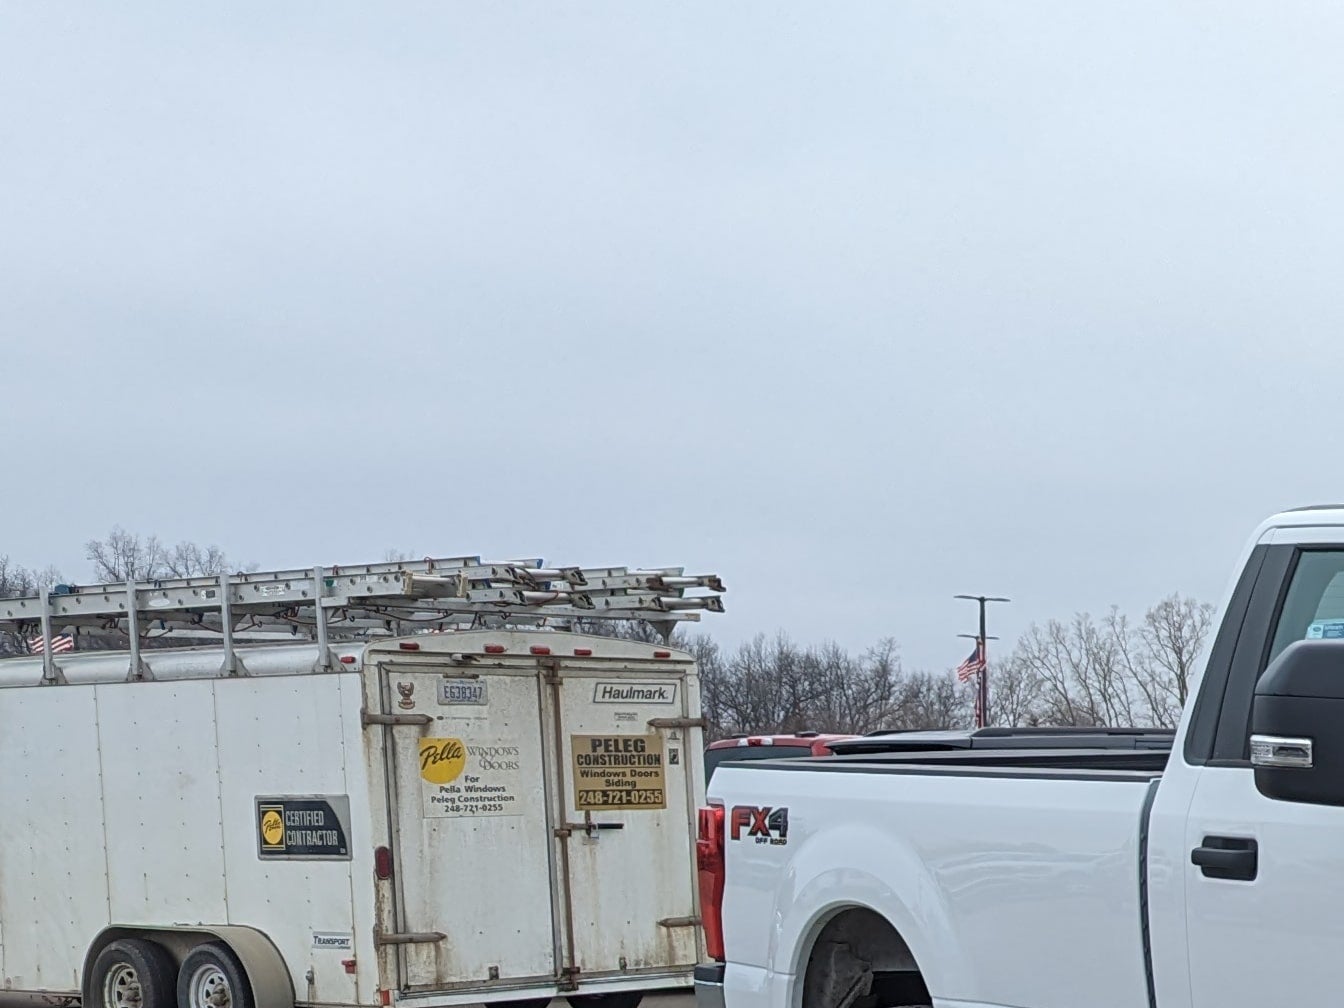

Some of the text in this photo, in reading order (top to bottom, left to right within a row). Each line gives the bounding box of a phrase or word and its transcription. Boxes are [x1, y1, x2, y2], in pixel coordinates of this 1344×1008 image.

[602, 686, 667, 699] Haulmark
[466, 745, 519, 756] WINDOWS
[591, 739, 646, 753] PELEG
[419, 741, 464, 770] Pella
[576, 753, 661, 766] CONSTRUCTION
[464, 775, 480, 783] For
[580, 769, 660, 778] Windows Doors
[464, 784, 506, 793] Windows
[605, 779, 637, 788] Siding
[431, 793, 515, 804] Peleg Construction
[579, 790, 663, 804] 248-721-0255
[444, 803, 504, 813] 248-721-0255
[286, 810, 324, 827] CERTIFIED
[731, 805, 788, 840] FX4
[286, 830, 338, 846] CONTRACTOR
